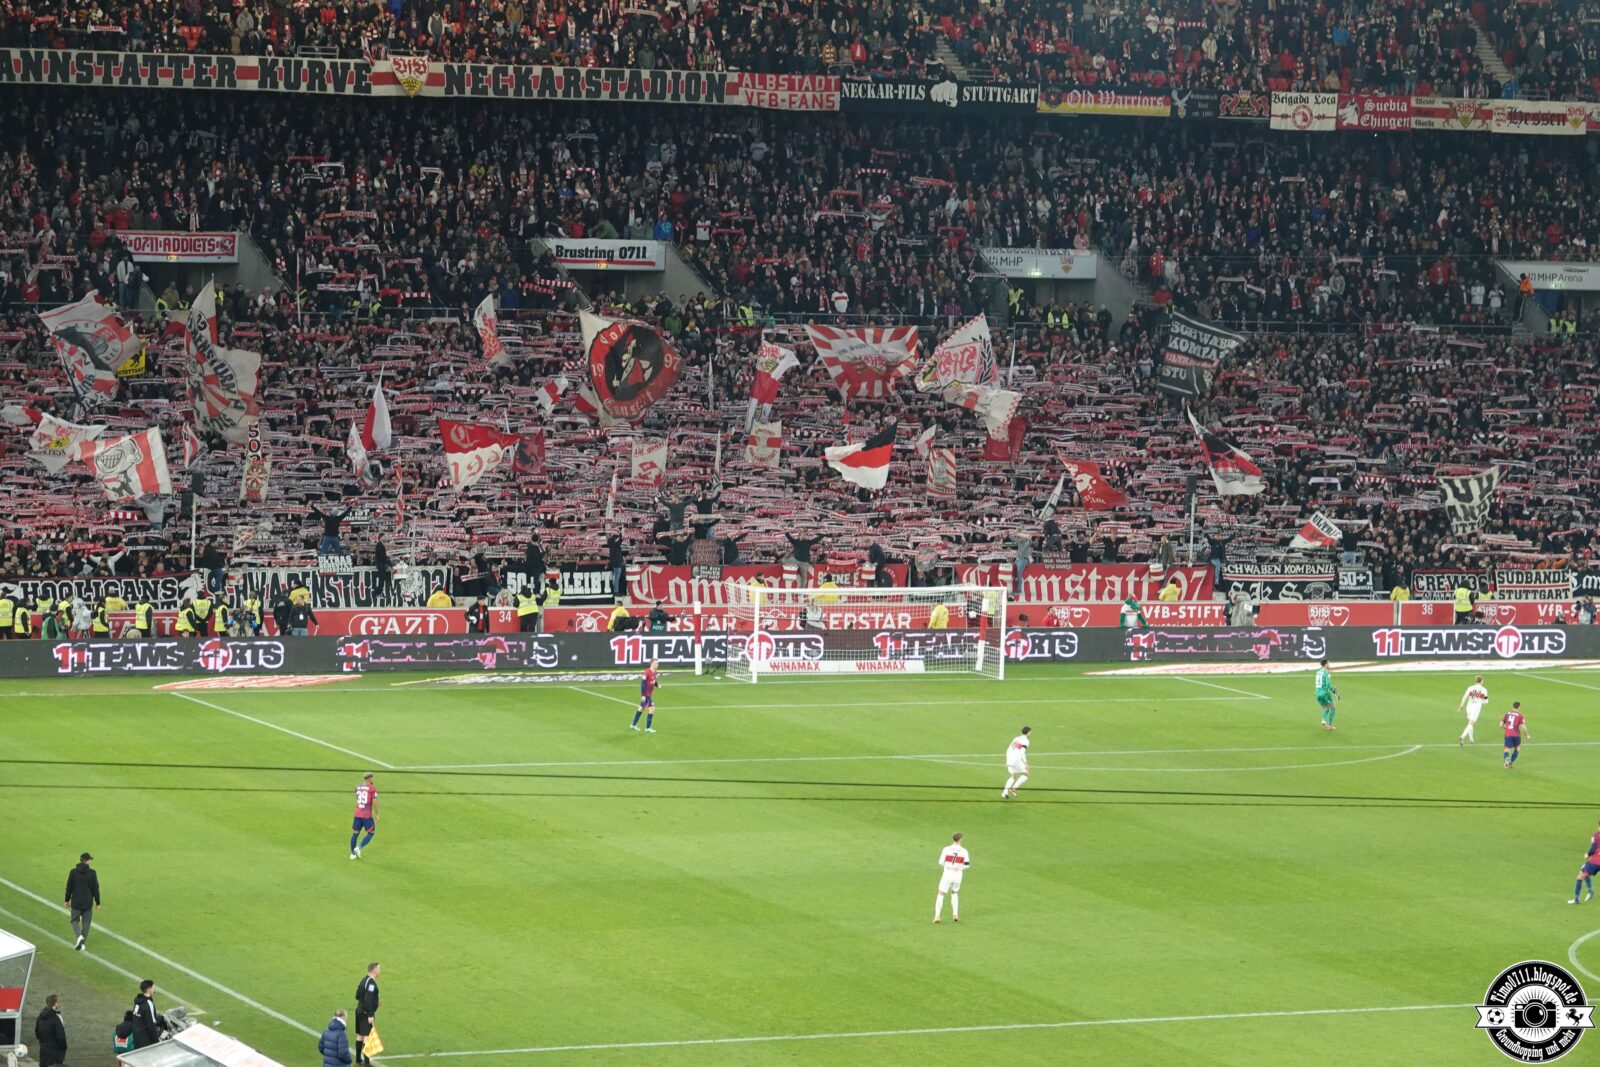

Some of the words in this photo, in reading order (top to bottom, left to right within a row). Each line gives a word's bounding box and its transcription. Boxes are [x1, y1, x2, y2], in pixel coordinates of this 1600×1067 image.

[258, 57, 372, 94] KURVE
[444, 65, 727, 103] NECKARSTADION
[742, 75, 838, 92] ALBSTADT
[744, 91, 837, 109] VFB-FANS
[841, 83, 926, 100] NECKAR-FILS
[962, 85, 1038, 104] STUTTGART
[1067, 89, 1094, 108] Old
[1098, 89, 1164, 109] Warriors
[1272, 93, 1309, 105] Brigada
[1314, 93, 1336, 105] Loca
[1364, 98, 1407, 112] Suebia
[1360, 115, 1411, 129] Ehingen
[133, 237, 158, 252] 0711
[163, 237, 216, 253] ADDICTS
[555, 245, 614, 261] Brustring
[619, 246, 647, 259] 0711
[1000, 256, 1024, 266] MHP
[1537, 273, 1558, 282] MHP
[591, 363, 604, 377] 19
[1162, 365, 1188, 380] STU
[318, 555, 352, 563] ULTRAS
[1222, 563, 1281, 574] SCHWABEN
[1284, 563, 1337, 574] KOMPANIE
[1339, 571, 1373, 586] 50+1
[1415, 574, 1463, 591] CREW
[19, 577, 179, 603] HOOLIGANS
[1499, 587, 1571, 600] STUTTGART
[499, 611, 511, 622] 34
[1142, 606, 1226, 618] VfB-STIFT
[1422, 604, 1433, 615] 36
[769, 661, 821, 672] WINAMAX
[855, 660, 906, 671] WINAMAX
[356, 790, 369, 804] 39
